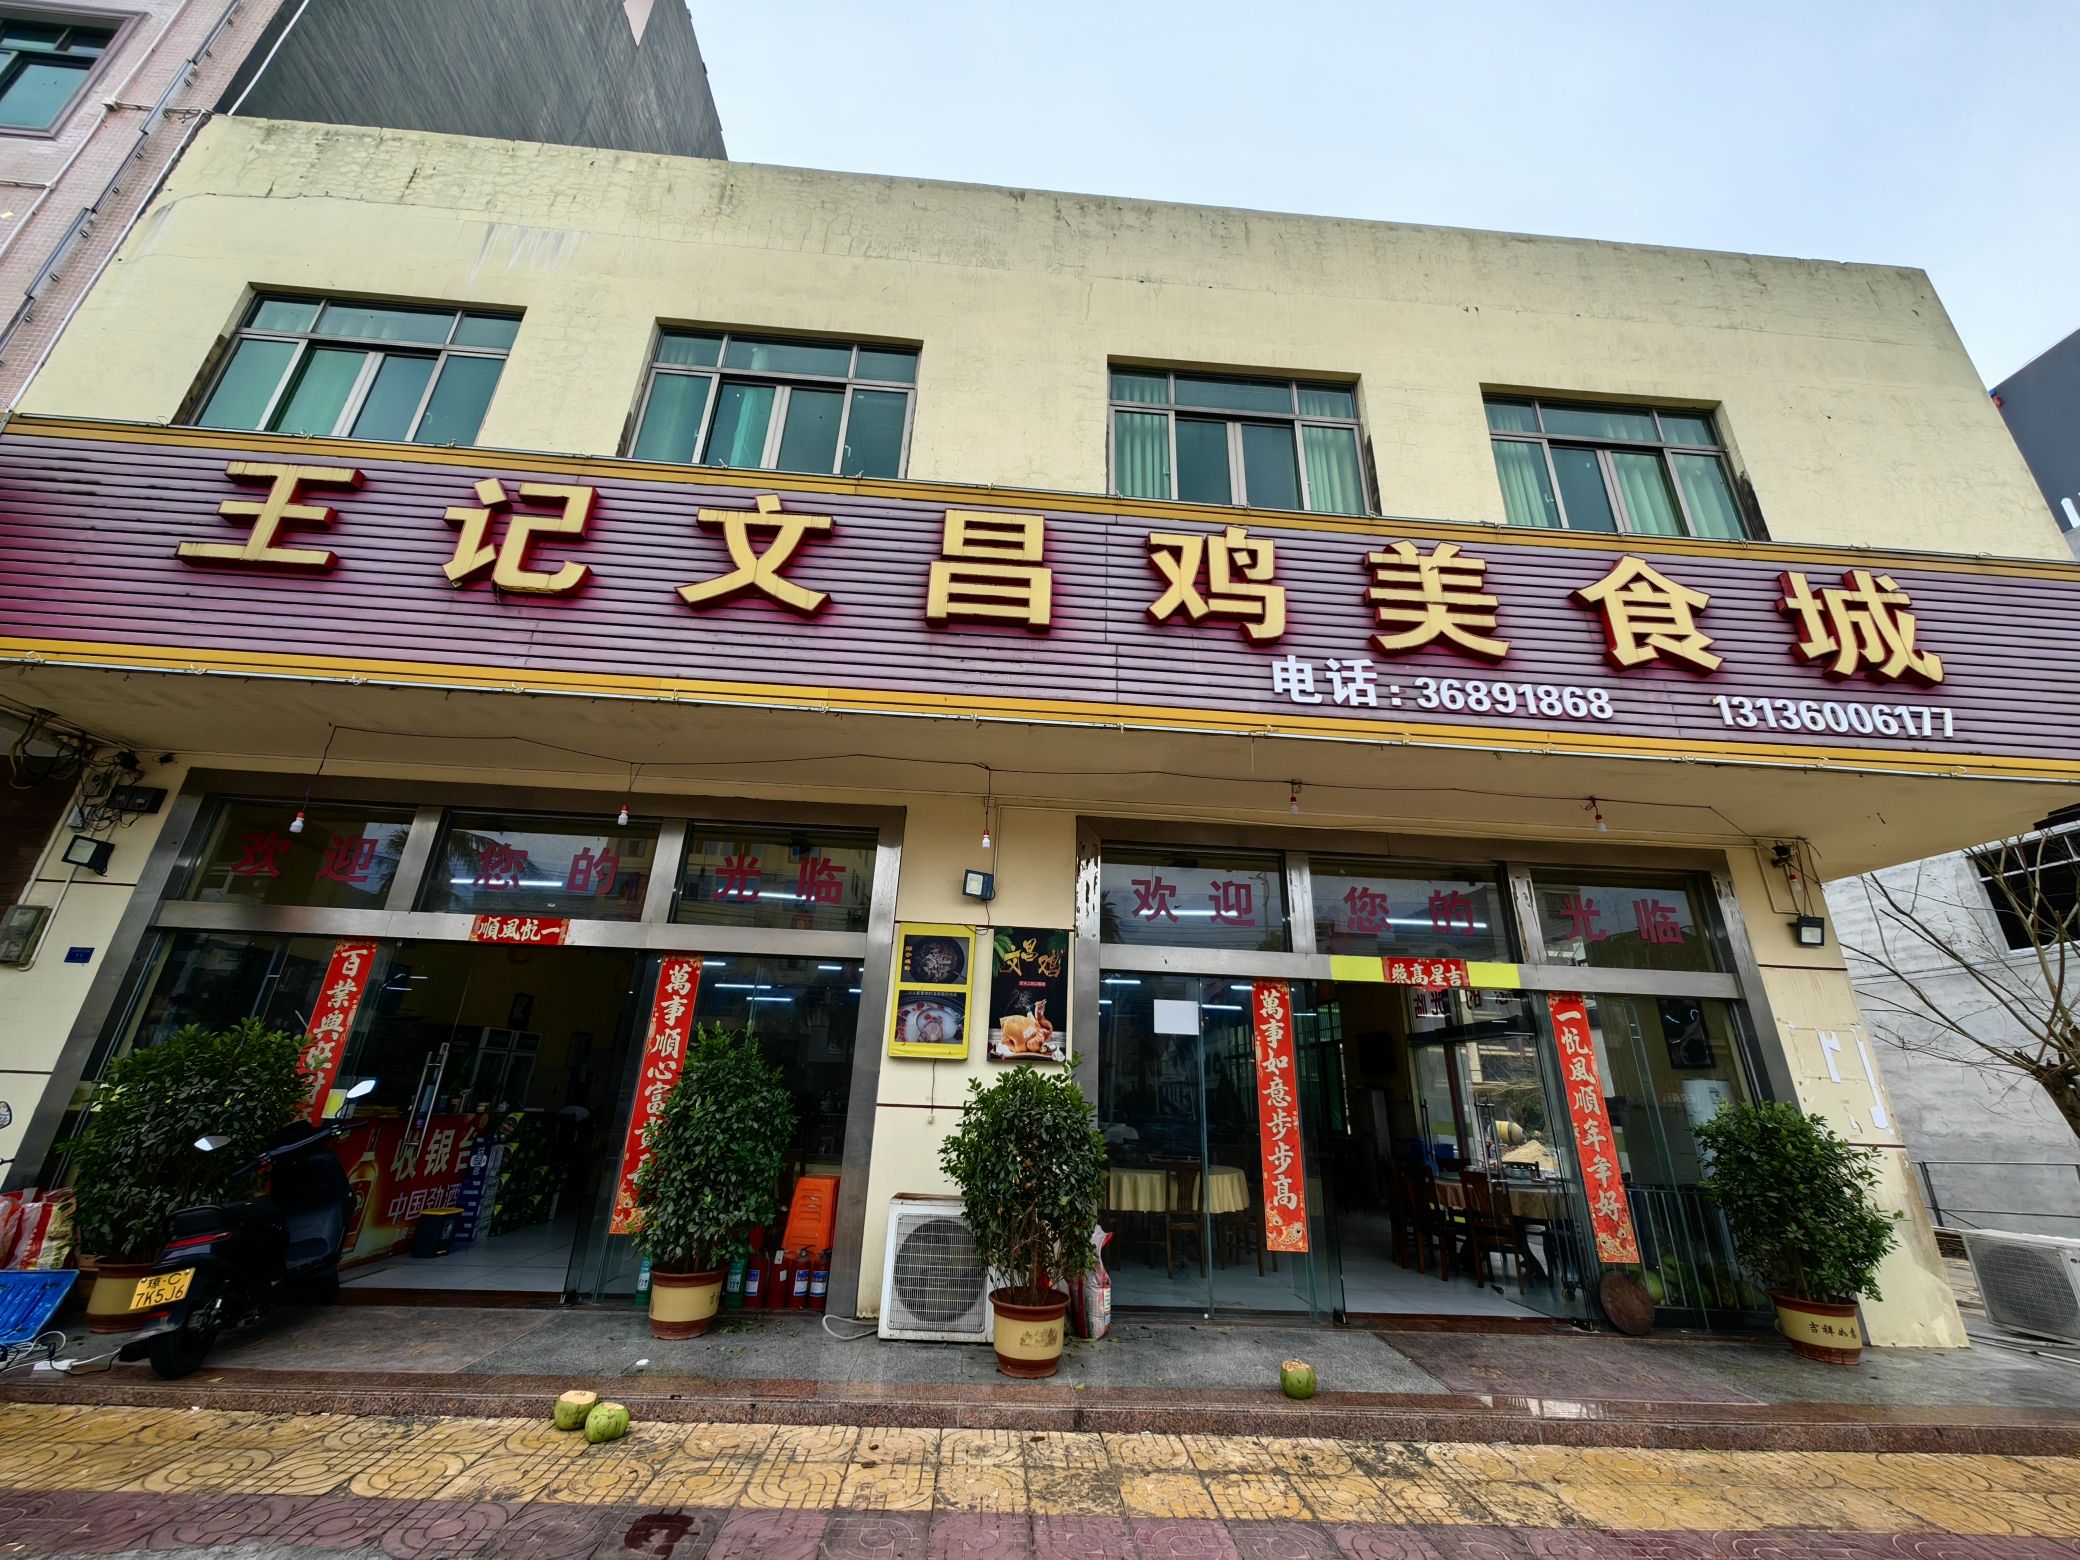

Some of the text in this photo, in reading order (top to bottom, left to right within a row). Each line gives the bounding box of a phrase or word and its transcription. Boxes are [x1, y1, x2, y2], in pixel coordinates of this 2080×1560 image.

[174, 460, 1944, 687] 王记文昌鸡美食城
[1711, 694, 1954, 739] 13136006177
[711, 852, 846, 905] 光临
[1130, 875, 1685, 945] 欢迎 您的 光临
[390, 1126, 478, 1183] 收银台
[135, 1284, 185, 1308] 7K5J6
